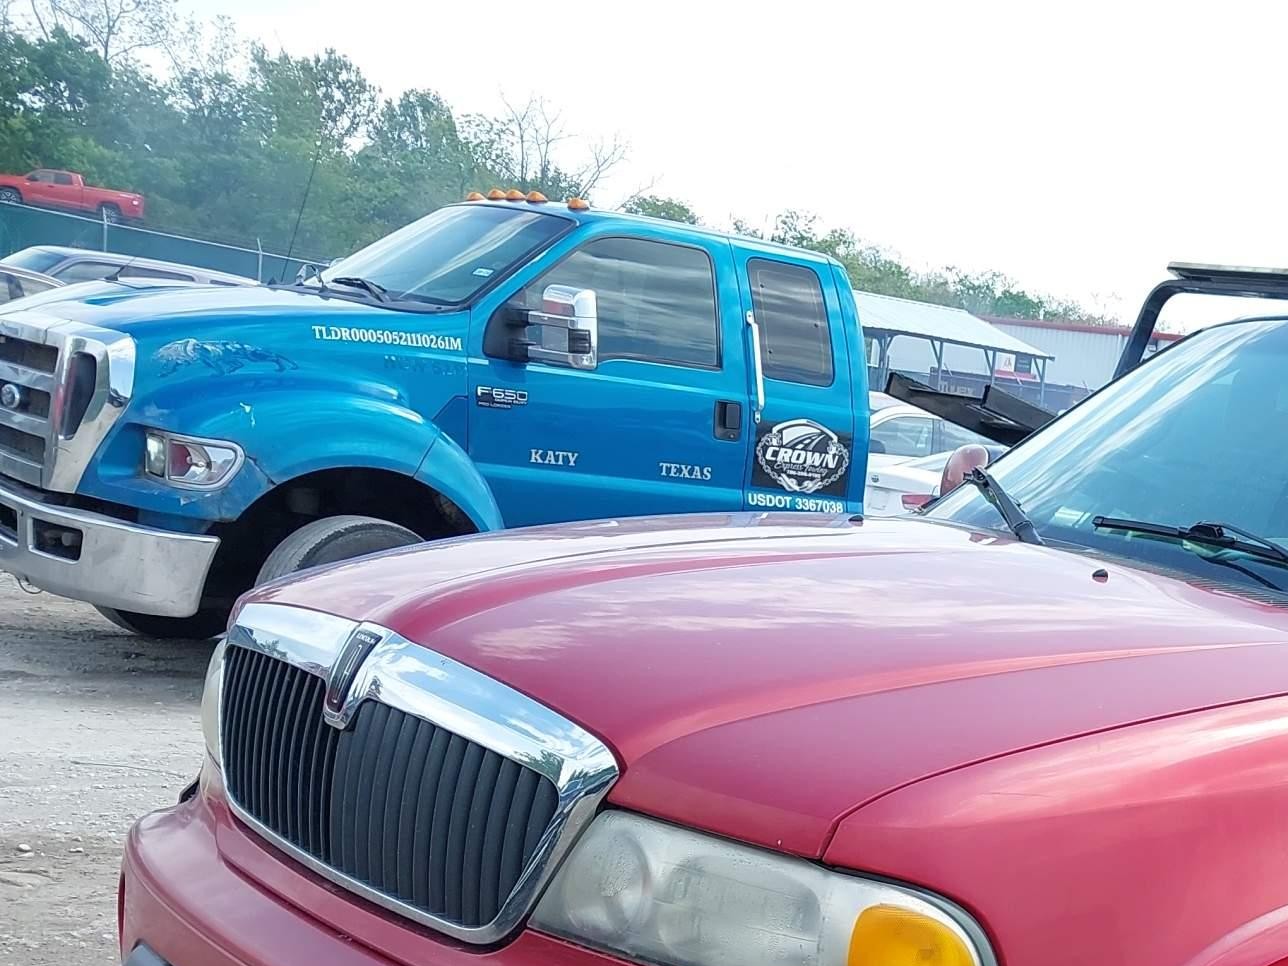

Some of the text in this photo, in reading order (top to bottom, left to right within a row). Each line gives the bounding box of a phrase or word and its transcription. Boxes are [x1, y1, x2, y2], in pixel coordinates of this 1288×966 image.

[529, 449, 712, 480] KATY TEXAS
[765, 446, 838, 469] CROWN
[748, 493, 844, 513] USDOT 3367038
